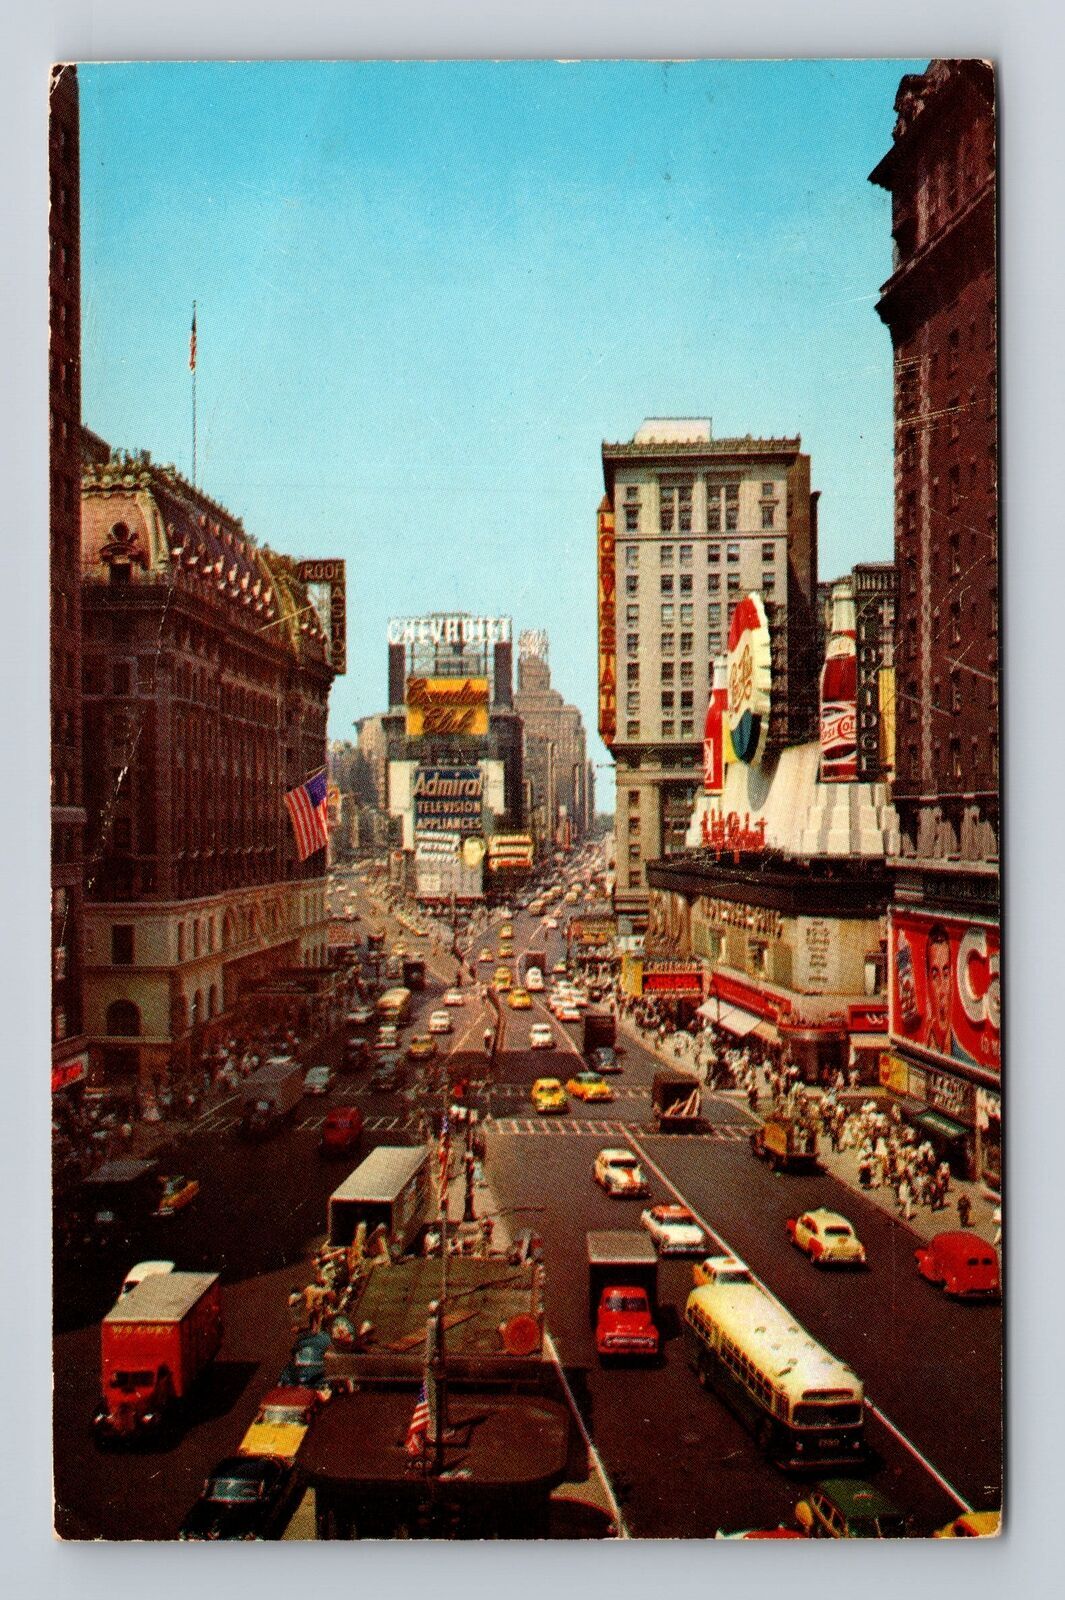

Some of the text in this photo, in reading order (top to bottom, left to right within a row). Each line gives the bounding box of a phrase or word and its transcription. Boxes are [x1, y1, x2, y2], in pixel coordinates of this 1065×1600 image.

[387, 617, 511, 644] CHEVROLET
[413, 771, 486, 796] Admiral
[416, 800, 481, 814] TELEVISION
[415, 817, 482, 830] APPLIANCES
